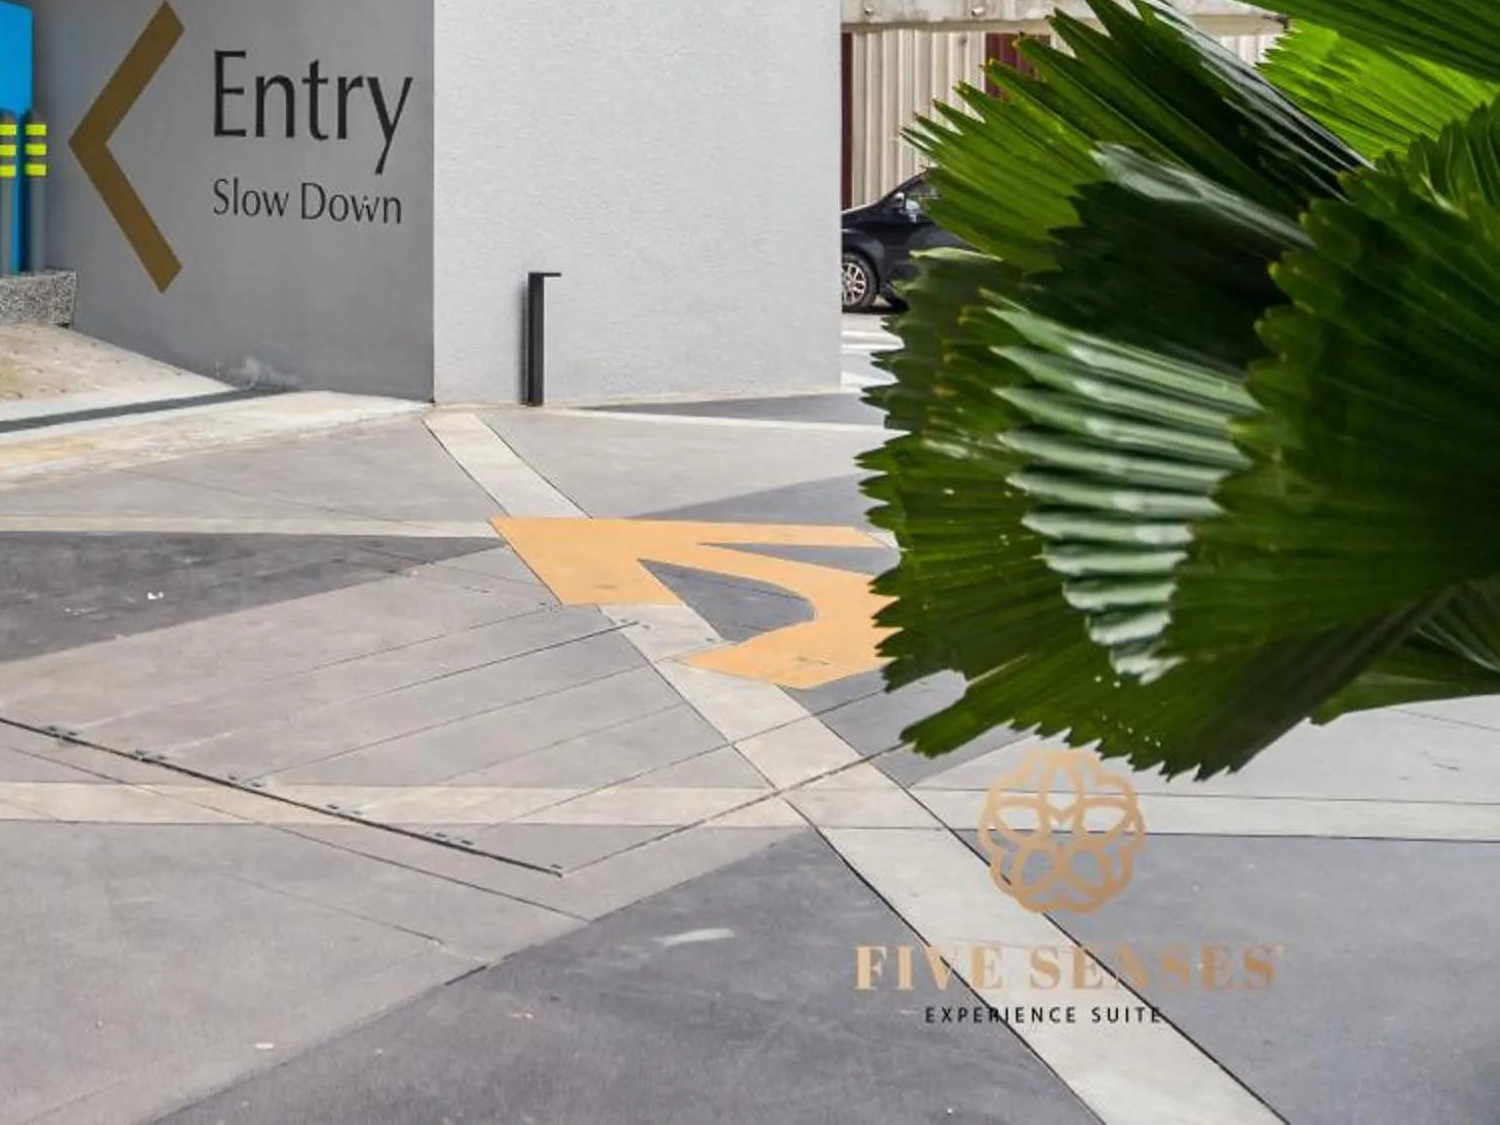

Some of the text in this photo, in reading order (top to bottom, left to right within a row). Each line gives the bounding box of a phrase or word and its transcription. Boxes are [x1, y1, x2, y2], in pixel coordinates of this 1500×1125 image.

[213, 49, 414, 176] Entry
[213, 177, 403, 224] Slow Down
